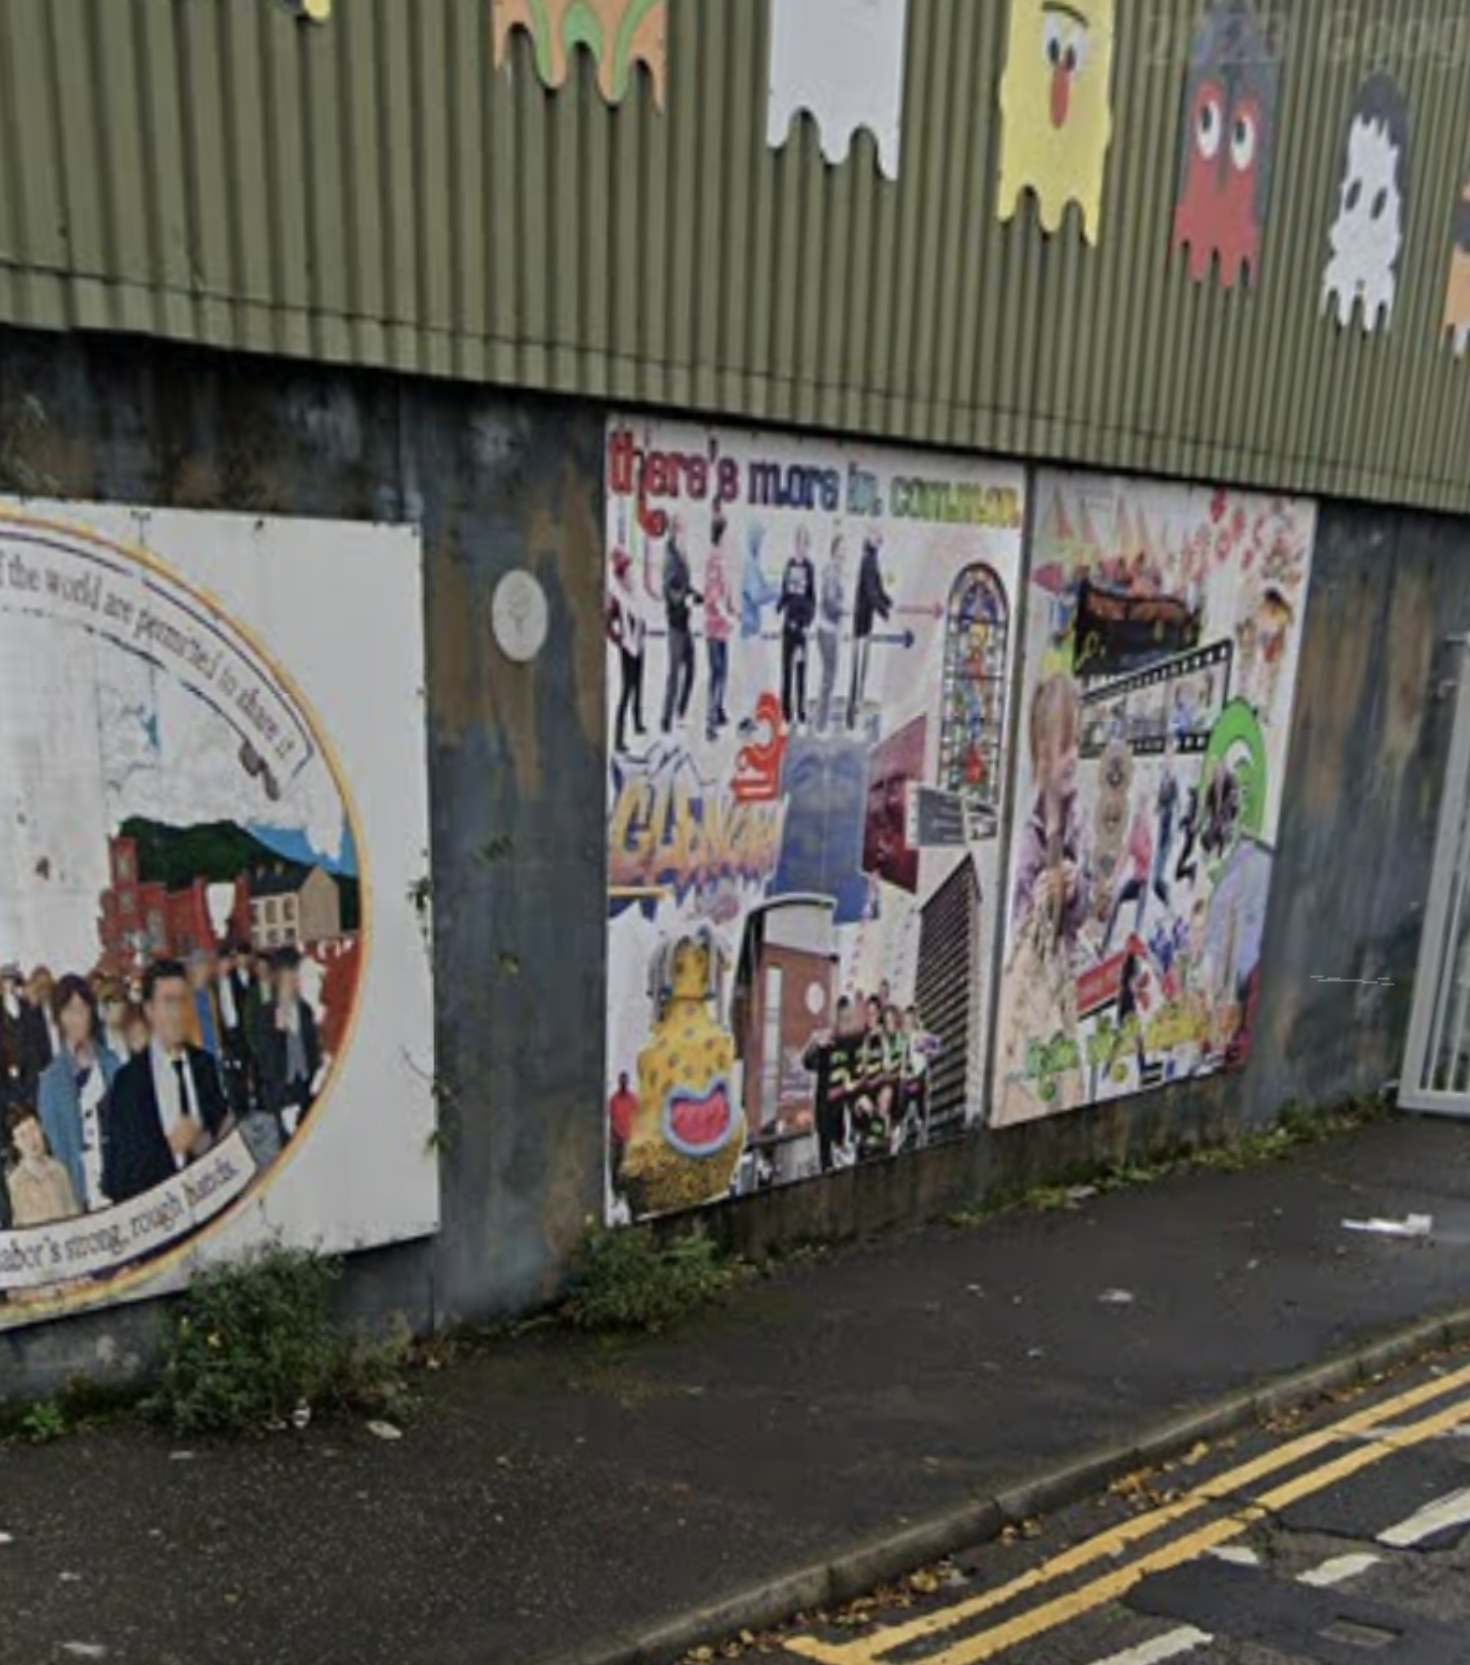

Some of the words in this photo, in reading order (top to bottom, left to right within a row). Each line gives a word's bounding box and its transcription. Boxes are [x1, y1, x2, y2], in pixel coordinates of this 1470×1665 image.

[607, 428, 739, 537] there's
[748, 458, 840, 513] more
[889, 475, 1021, 529] common
[8, 553, 40, 592] the
[44, 568, 103, 612] world
[103, 591, 134, 625] are
[133, 608, 223, 679] permitted
[236, 688, 279, 743] share
[129, 1190, 186, 1236] rough
